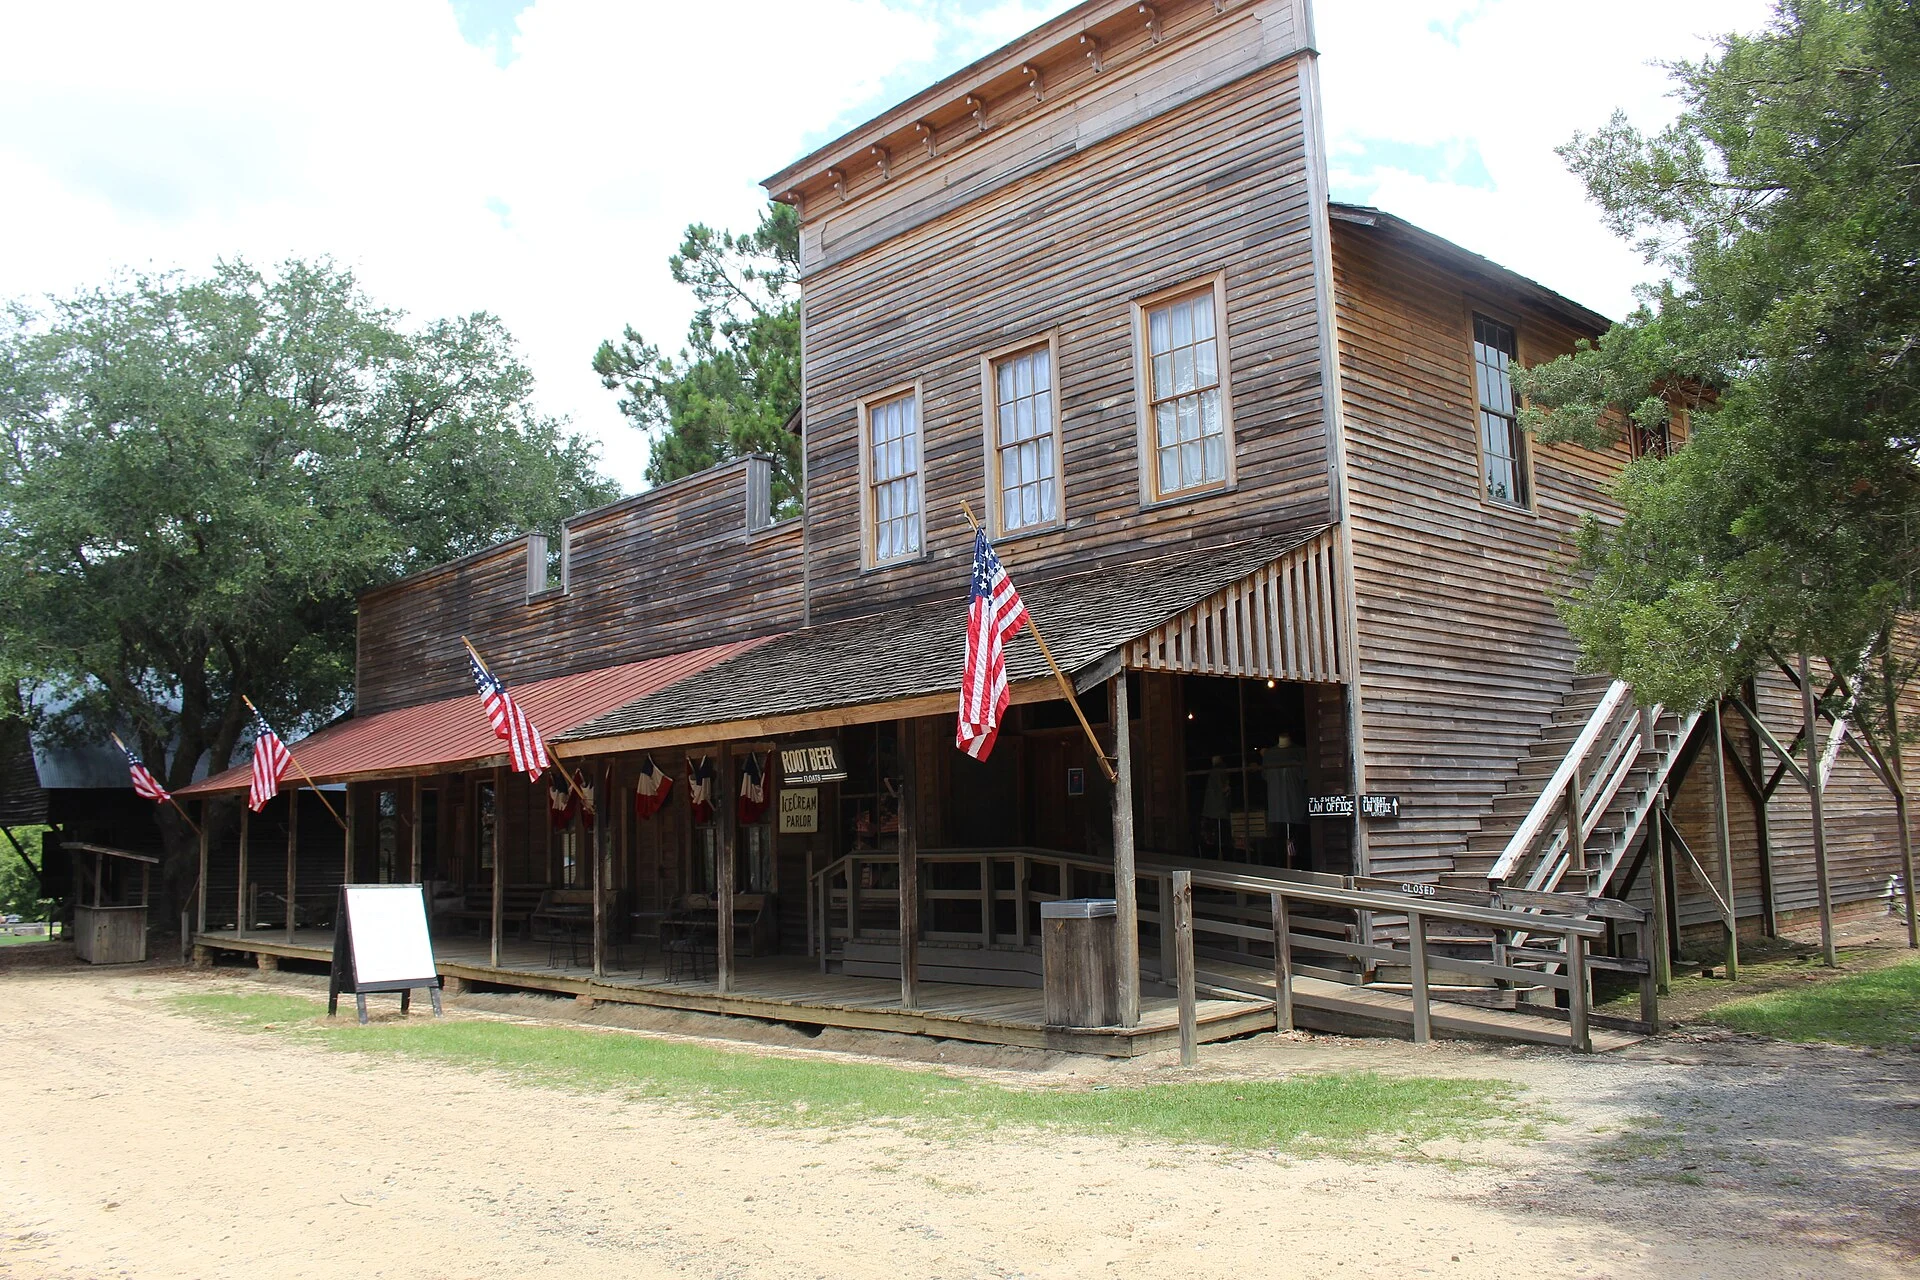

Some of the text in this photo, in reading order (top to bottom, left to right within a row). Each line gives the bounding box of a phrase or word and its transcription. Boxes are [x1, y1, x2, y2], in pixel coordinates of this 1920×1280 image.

[781, 746, 837, 774] ROOT BEER
[803, 774, 821, 783] FLOATS
[1308, 801, 1354, 813] LAW OFFICE
[1374, 803, 1391, 813] OFFICE
[786, 815, 812, 828] PARLOR
[1402, 883, 1436, 896] CLOSED
